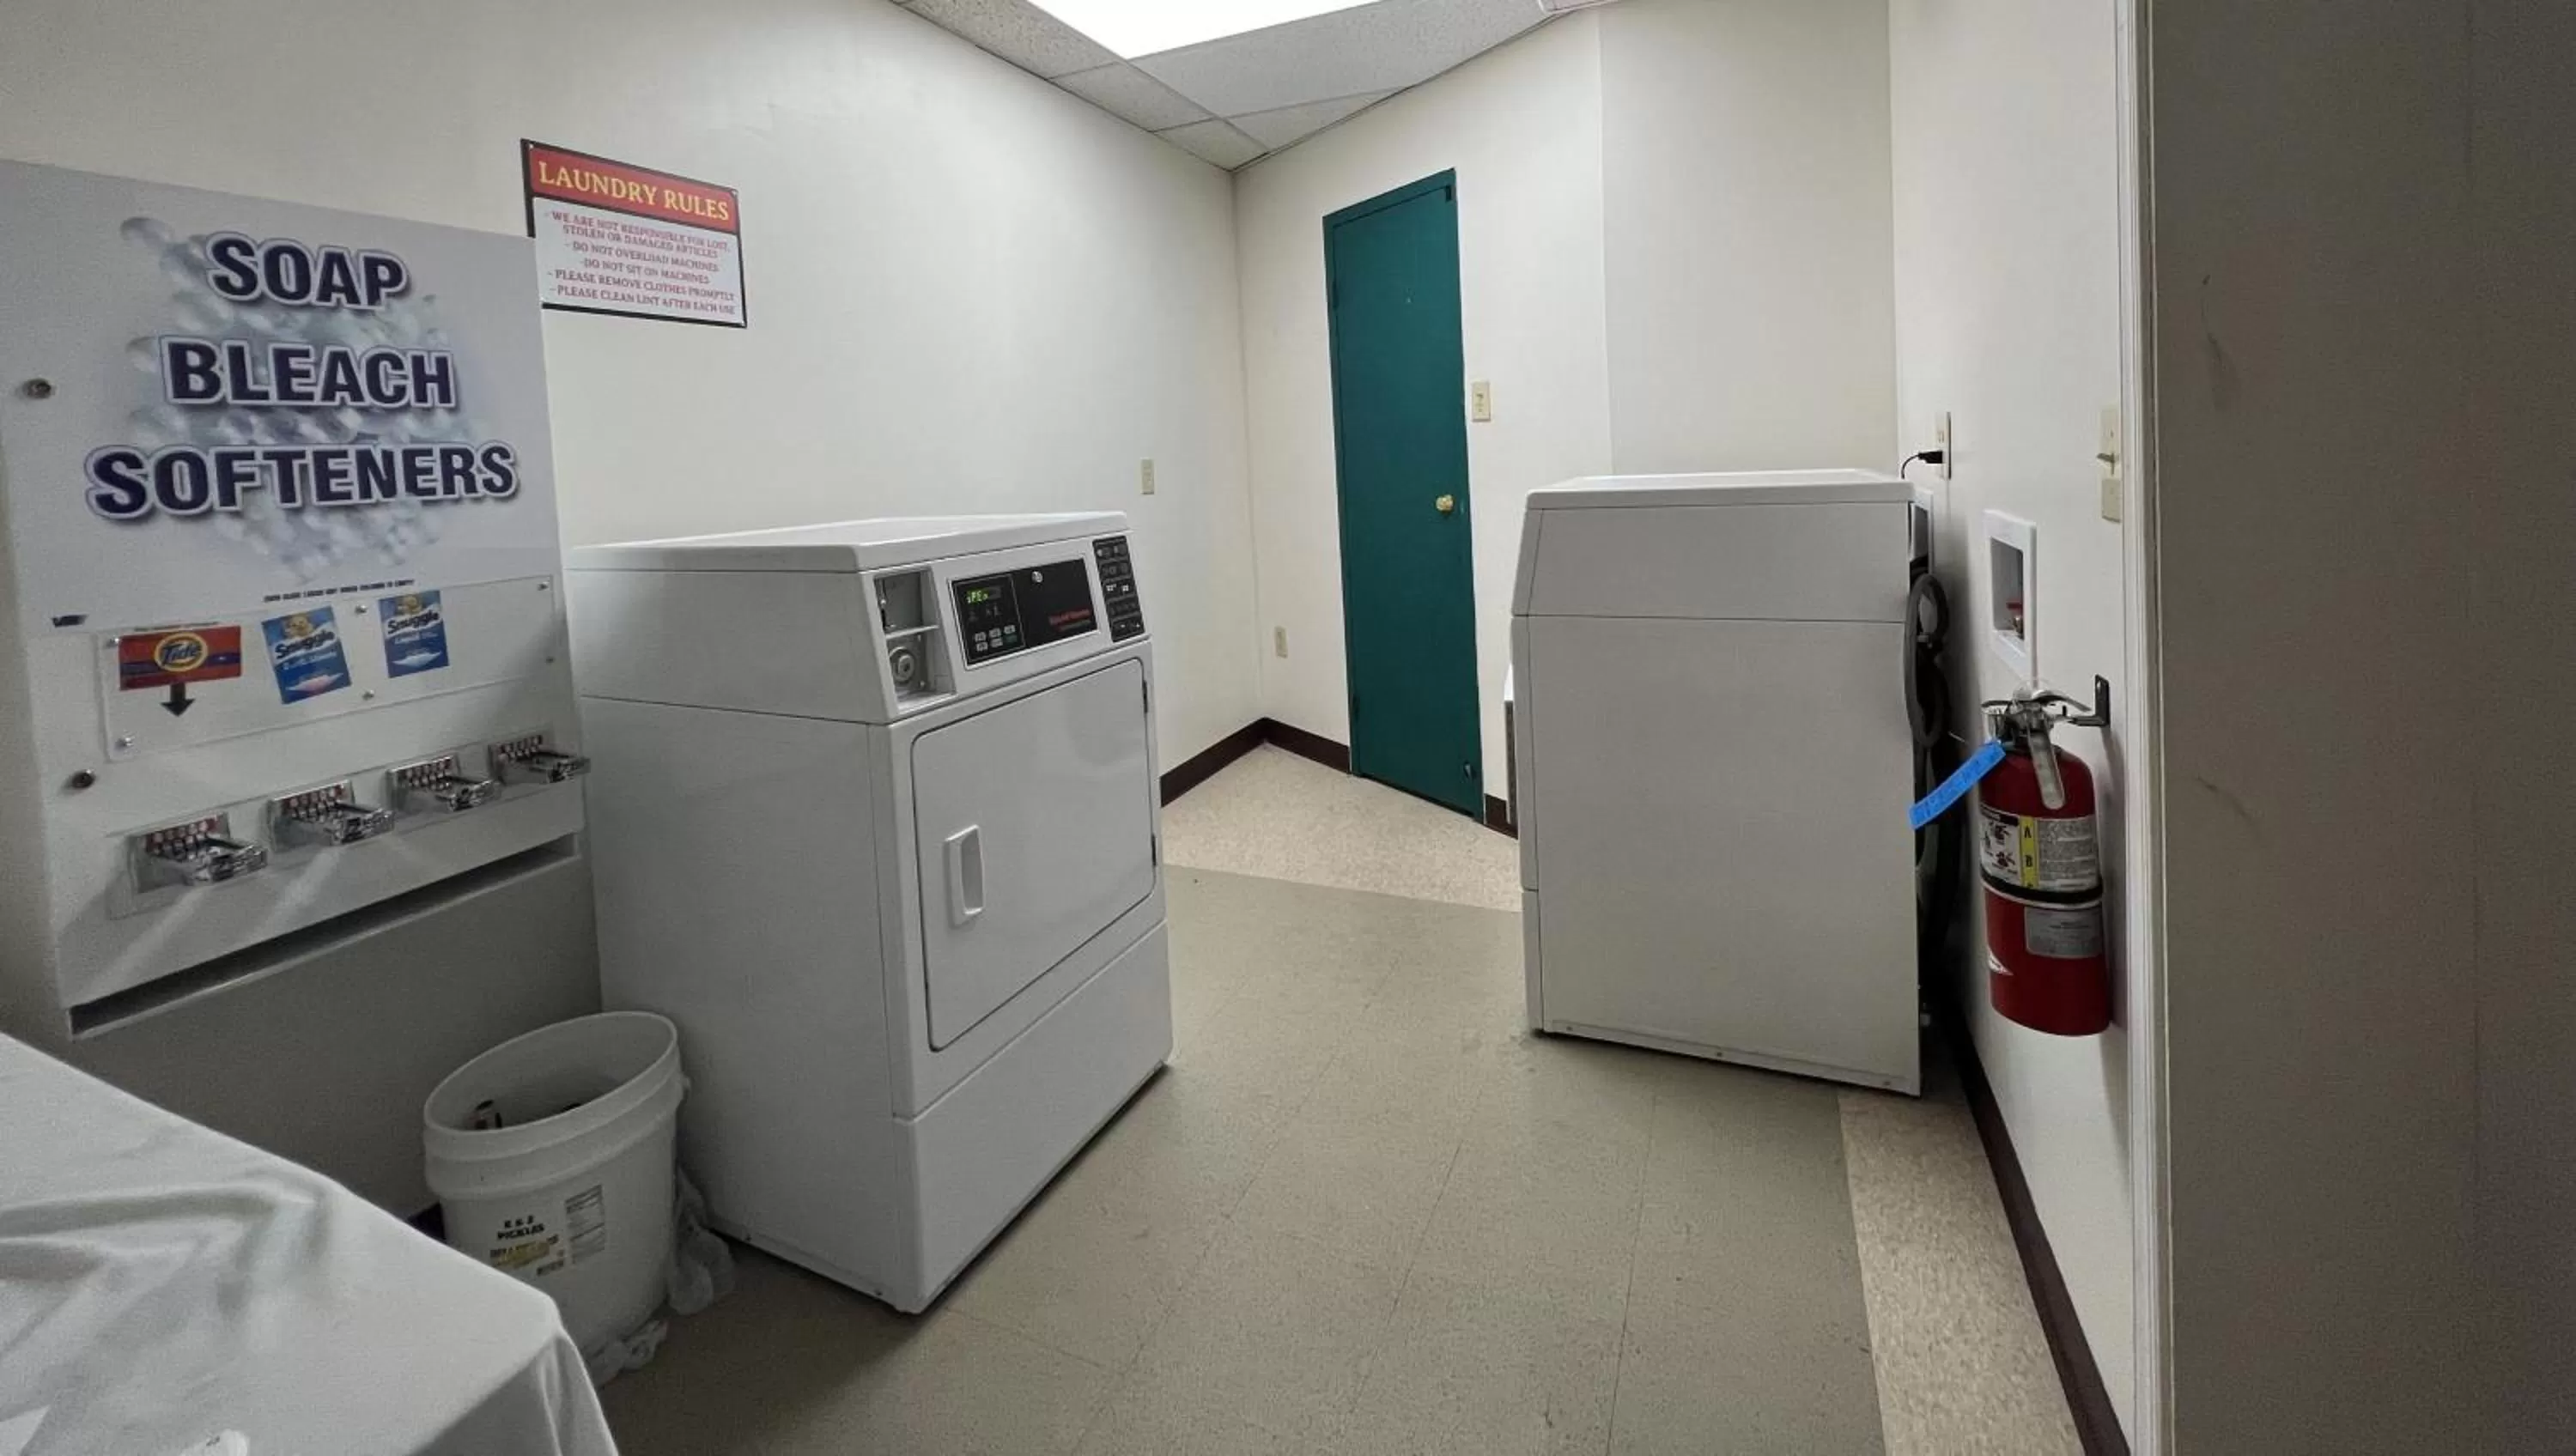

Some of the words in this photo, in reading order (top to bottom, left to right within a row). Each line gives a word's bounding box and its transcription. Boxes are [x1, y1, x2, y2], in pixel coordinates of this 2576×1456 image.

[538, 161, 657, 205] LAUNDRY
[664, 189, 729, 221] RULES
[552, 211, 569, 222] WE
[573, 215, 594, 227] ARE
[573, 241, 588, 252] DO
[591, 246, 612, 256] NOT
[208, 233, 406, 309] SOAP
[603, 261, 623, 271] NOT
[556, 270, 597, 284] PLEASE
[598, 275, 641, 289] REMOVE
[644, 281, 687, 294] CLOTHES
[557, 285, 598, 300] PLEASE
[601, 290, 635, 303] CLEAN
[161, 337, 455, 408] BLEACH
[88, 441, 519, 518] SOFTENERS
[387, 610, 440, 634] Snuggle
[160, 639, 203, 665] Tide
[275, 630, 337, 659] Snuggle
